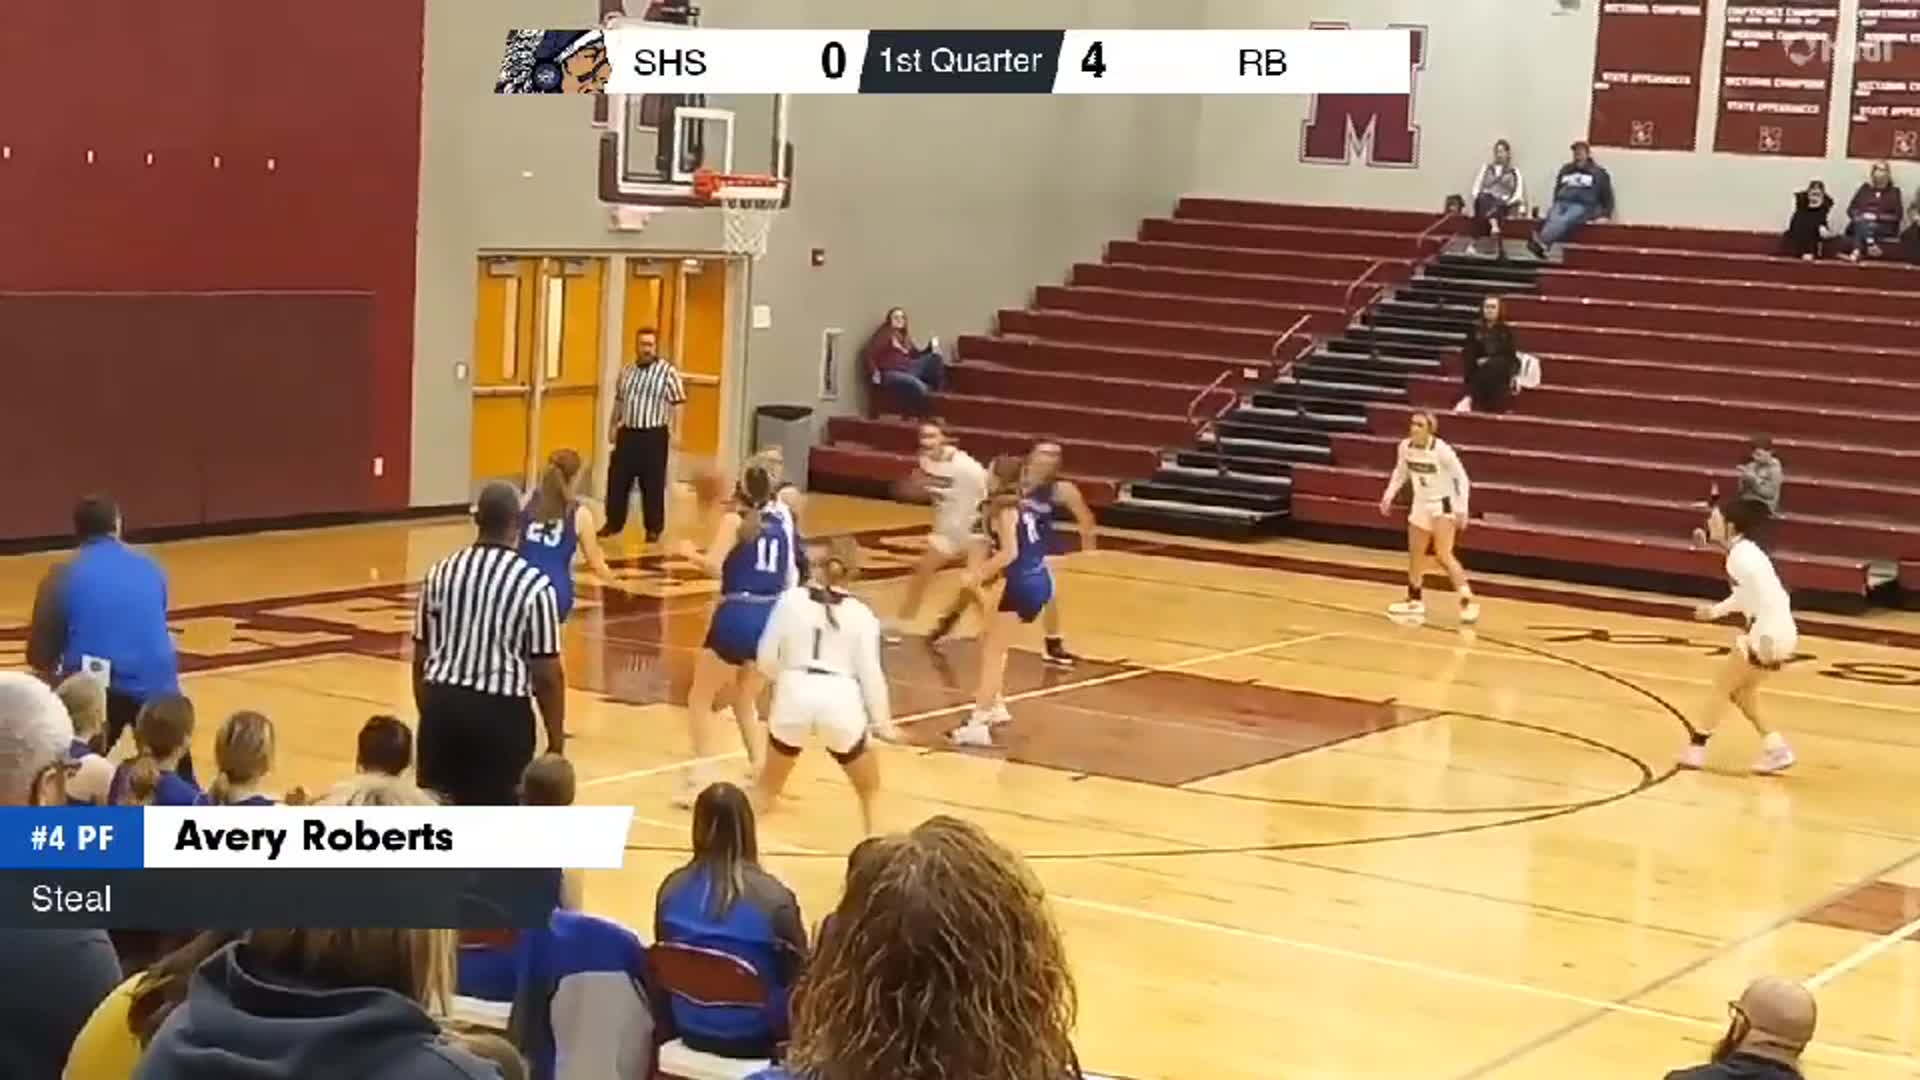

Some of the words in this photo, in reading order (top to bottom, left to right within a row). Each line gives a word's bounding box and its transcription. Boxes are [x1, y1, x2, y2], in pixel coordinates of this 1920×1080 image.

[526, 518, 564, 548] 23
[755, 536, 780, 573] 11
[811, 627, 822, 661] 1
